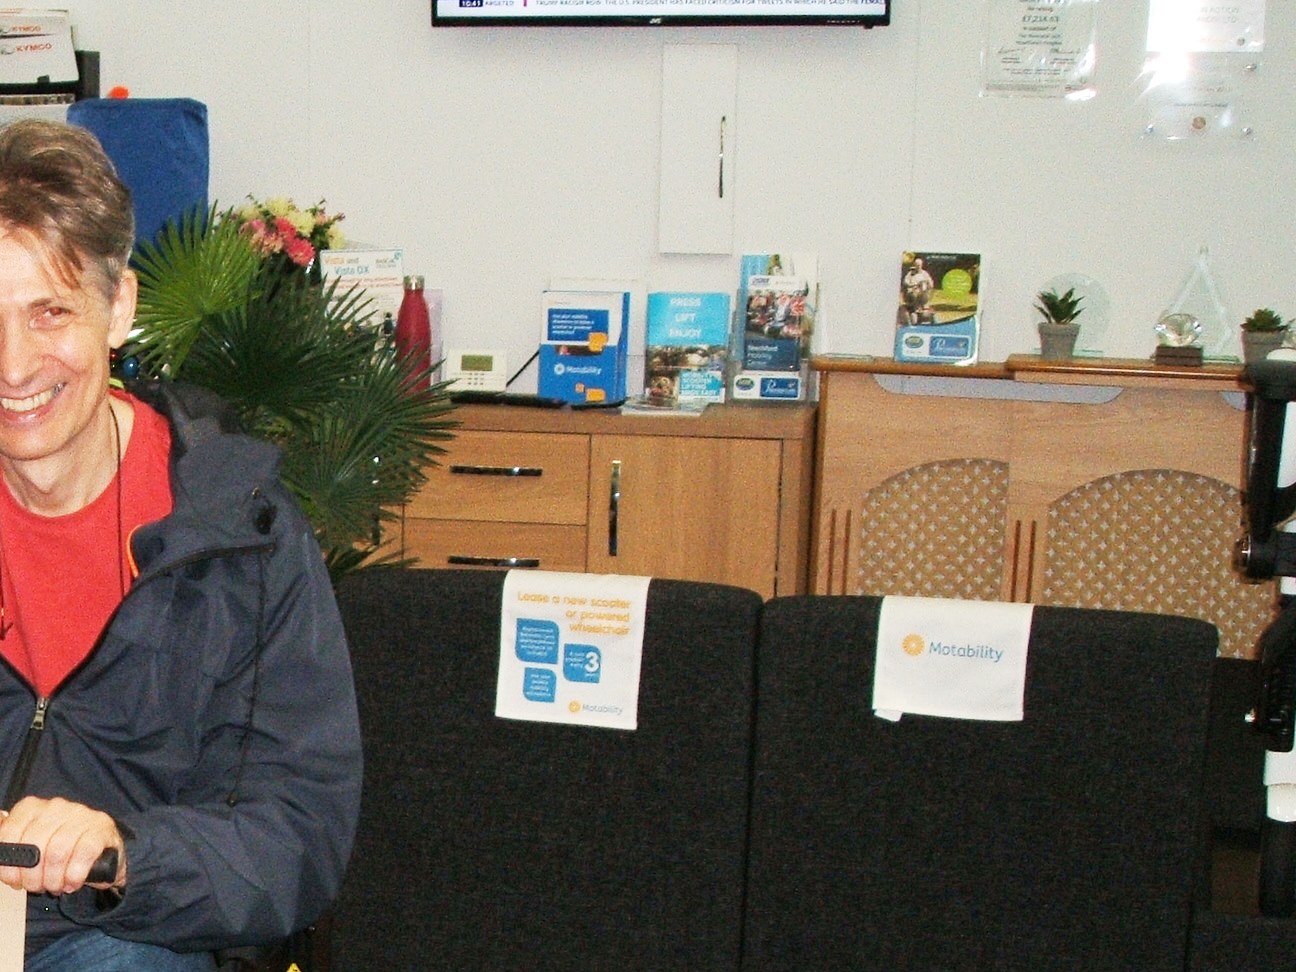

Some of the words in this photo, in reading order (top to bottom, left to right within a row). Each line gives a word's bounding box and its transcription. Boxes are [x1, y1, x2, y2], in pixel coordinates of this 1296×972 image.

[16, 43, 52, 52] KYMCO
[670, 298, 702, 307] PRESS
[668, 328, 702, 338] ENJOY
[518, 592, 549, 603] Lease
[564, 597, 587, 605] new
[591, 598, 631, 609] scooter
[580, 610, 630, 622] powered
[569, 622, 630, 635] wheelchair
[929, 641, 1004, 663] Motability
[584, 651, 600, 673] 3
[583, 704, 623, 716] Motability
